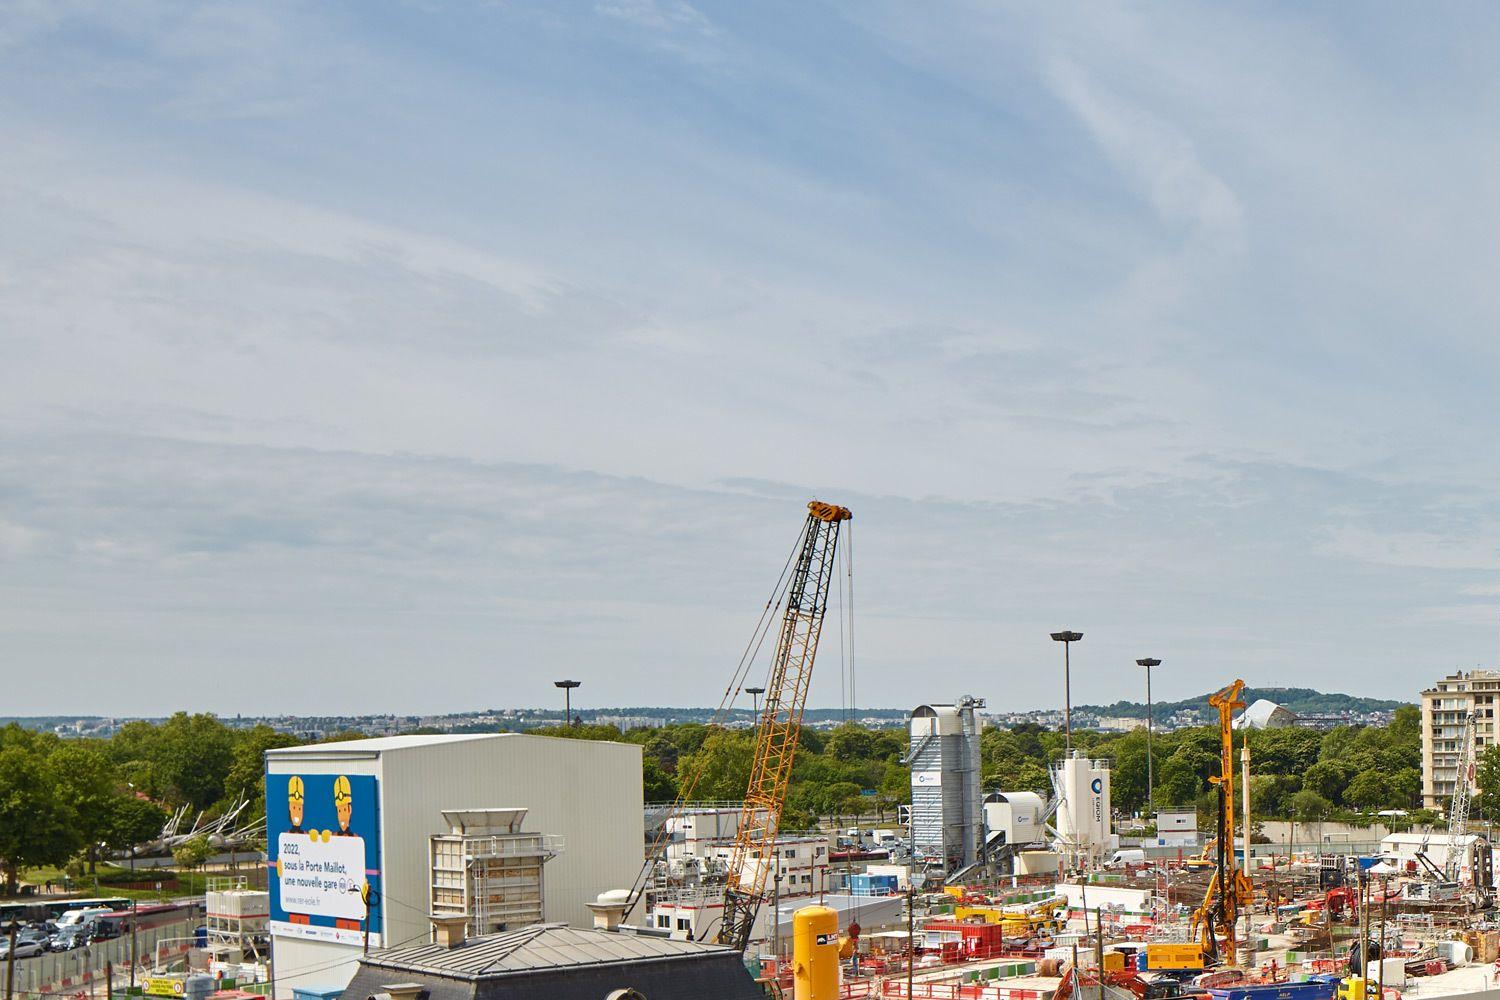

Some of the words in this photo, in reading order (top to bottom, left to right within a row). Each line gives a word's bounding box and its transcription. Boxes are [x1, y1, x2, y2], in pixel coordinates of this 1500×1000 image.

[283, 843, 300, 856] 2022,
[284, 862, 297, 871] sous
[298, 860, 305, 871] la
[305, 861, 322, 873] Porte
[323, 862, 347, 875] Maillot,
[284, 878, 296, 886] une
[296, 877, 322, 888] nouvelle
[323, 881, 338, 892] gare
